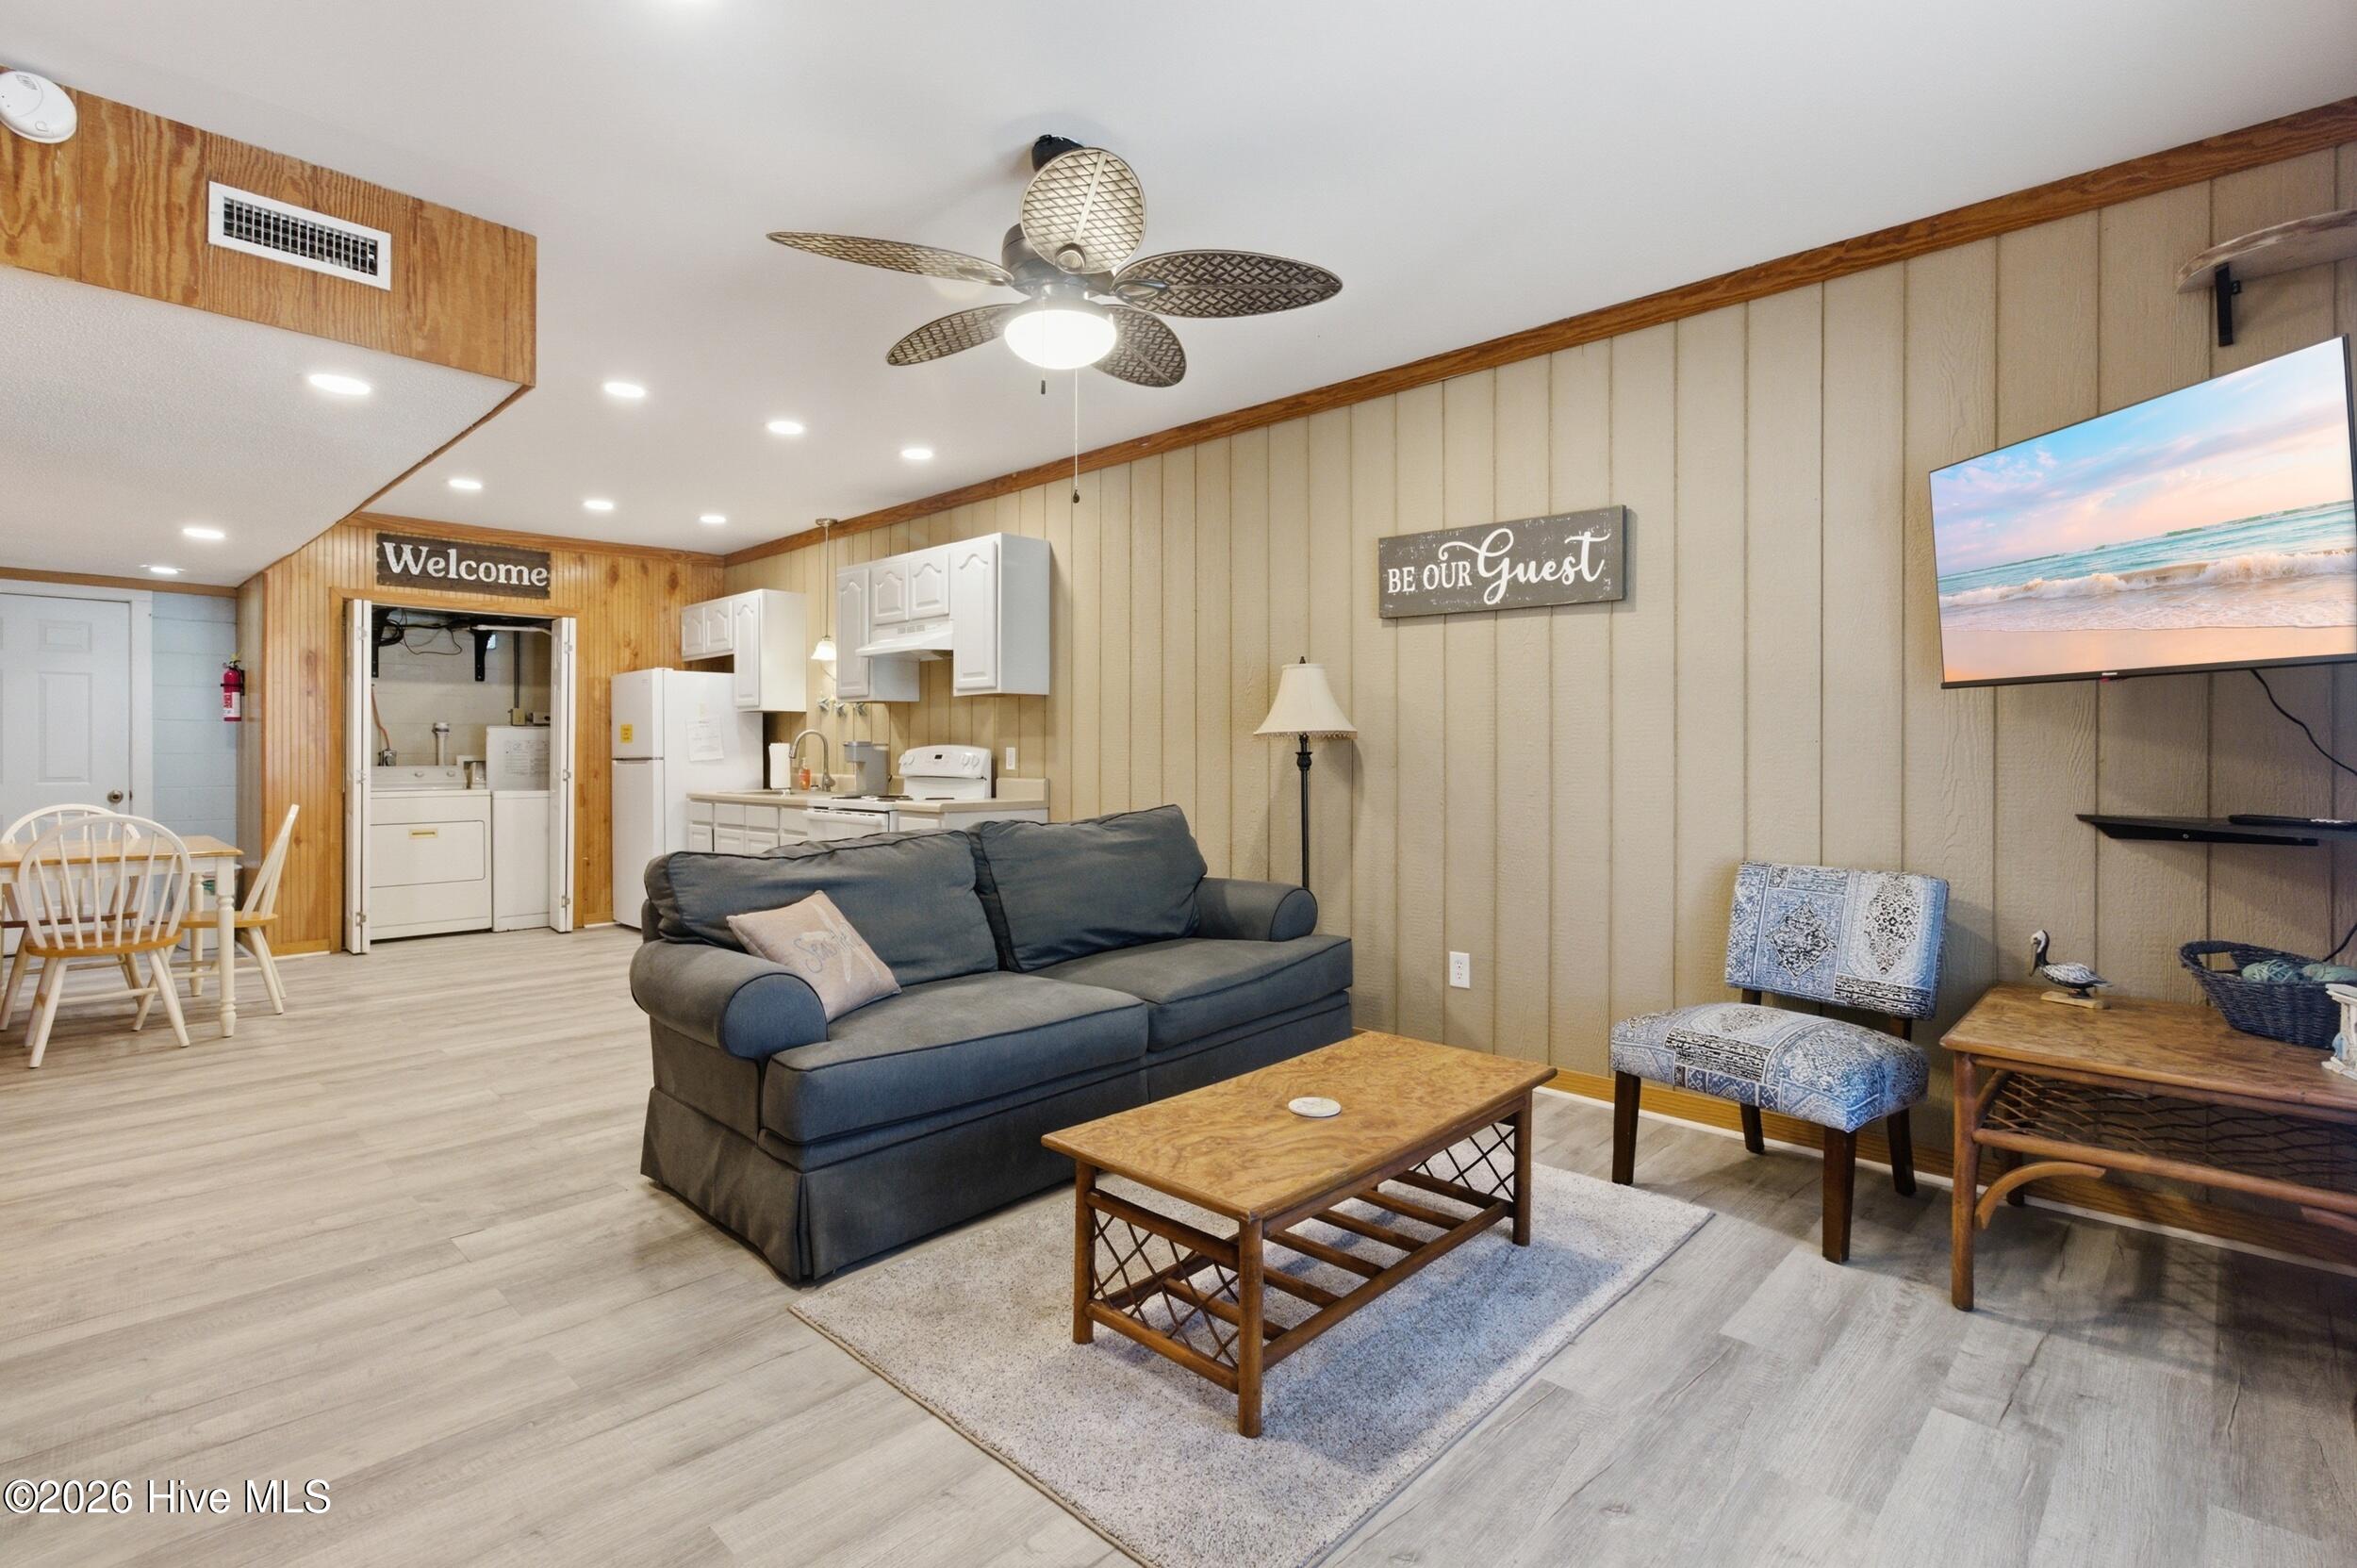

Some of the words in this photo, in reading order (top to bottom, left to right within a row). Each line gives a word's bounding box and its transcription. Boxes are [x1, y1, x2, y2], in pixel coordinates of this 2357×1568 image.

[383, 541, 549, 586] Welcome
[1387, 566, 1416, 593] BE
[1422, 561, 1473, 590] OUR
[1438, 528, 1611, 604] Guest
